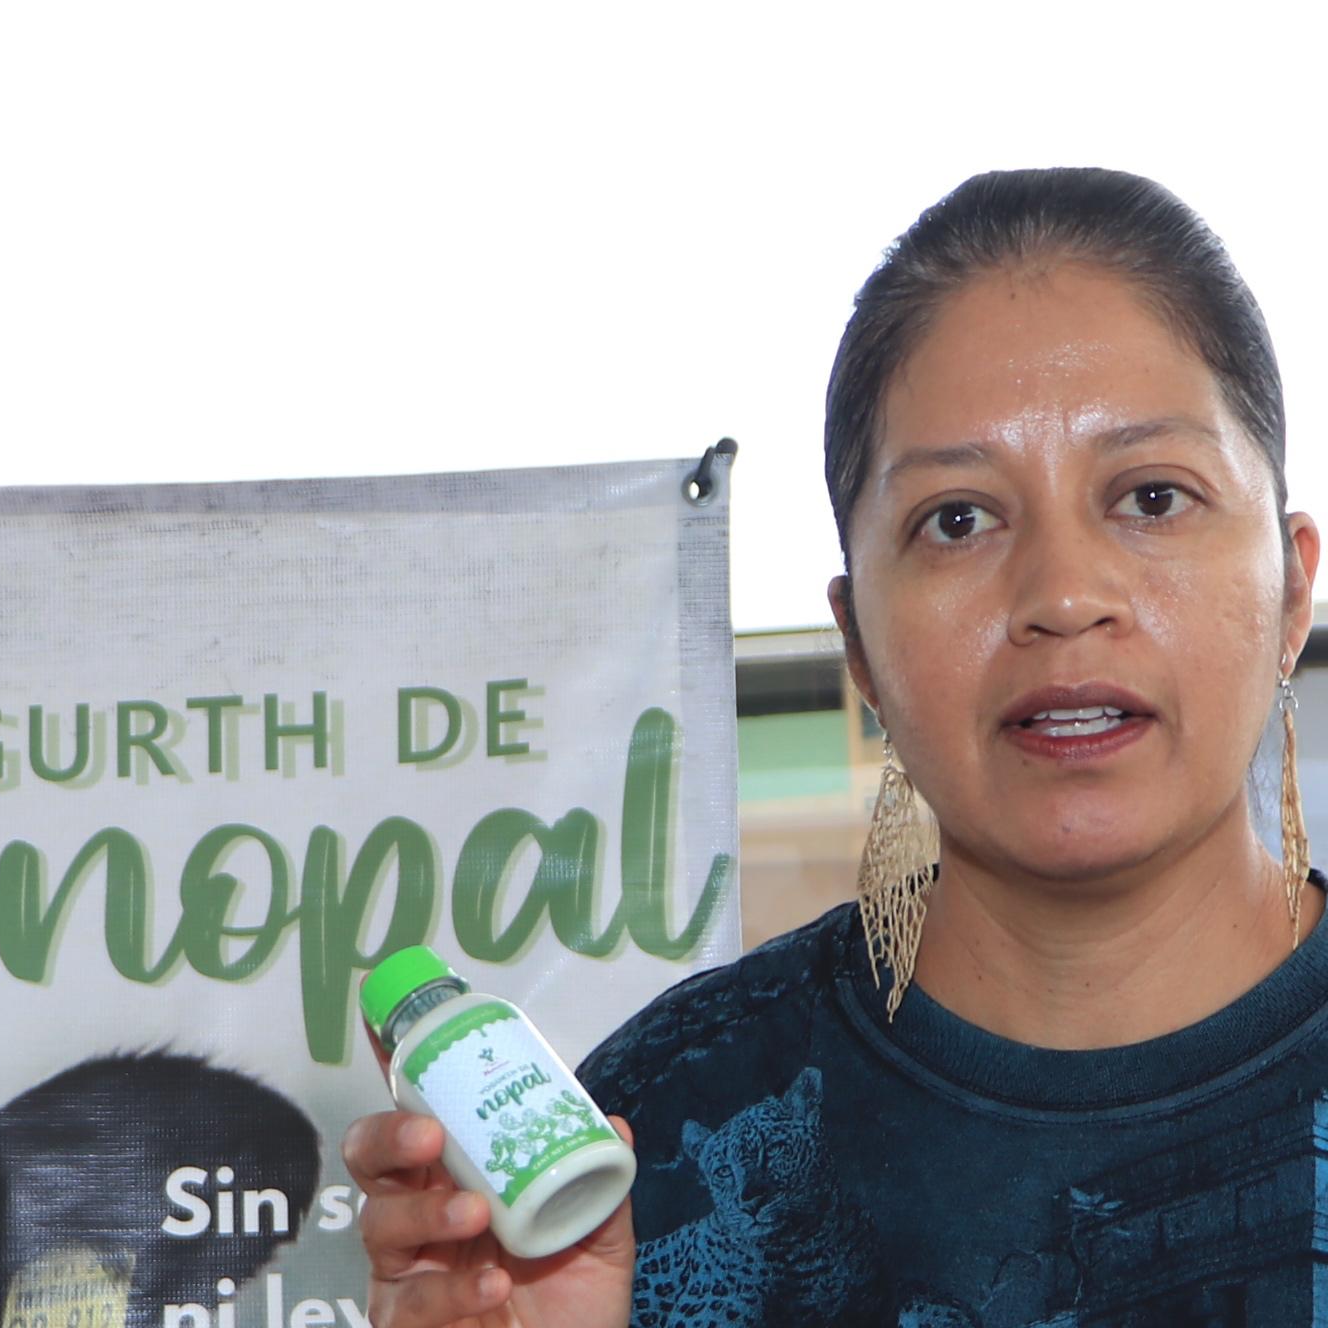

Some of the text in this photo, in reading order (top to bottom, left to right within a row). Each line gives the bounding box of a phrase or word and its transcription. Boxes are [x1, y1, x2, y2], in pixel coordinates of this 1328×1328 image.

[396, 677, 540, 770] DE
[476, 1062, 552, 1120] nopal
[161, 1166, 368, 1236] Sin s
